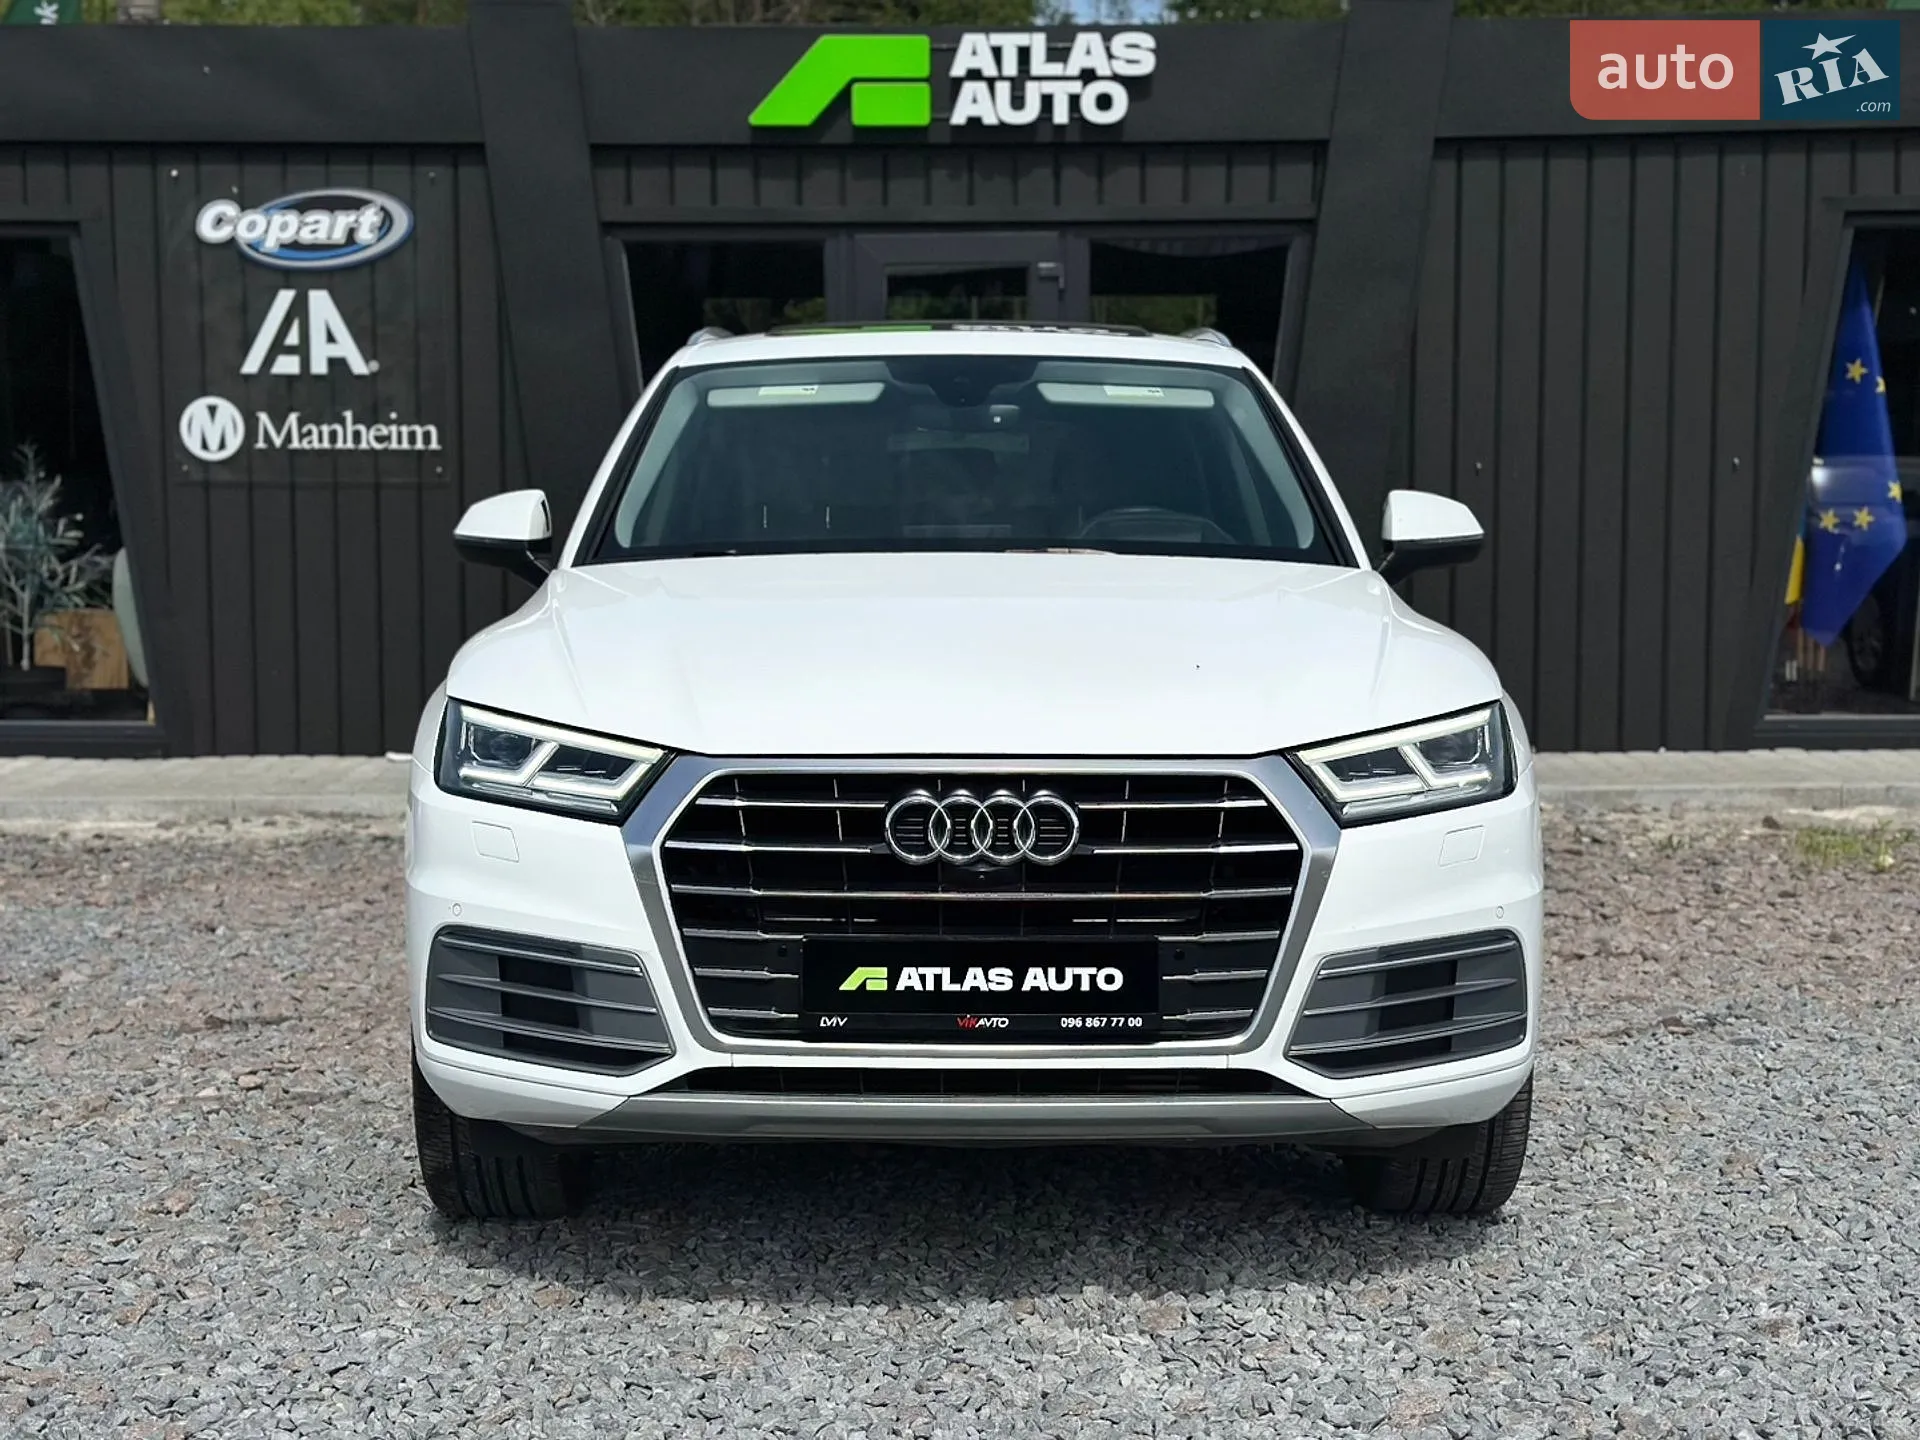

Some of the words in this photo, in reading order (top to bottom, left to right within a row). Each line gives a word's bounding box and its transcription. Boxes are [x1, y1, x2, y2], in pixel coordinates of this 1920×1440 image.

[949, 31, 1157, 77] ATLAS
[949, 79, 1129, 126] AUTO
[196, 199, 384, 252] Copart
[254, 410, 442, 451] Manheim
[895, 966, 1014, 992] ATLAS
[1021, 966, 1125, 992] AUTO
[1061, 1016, 1082, 1028] 096
[1085, 1016, 1107, 1028] 867
[1110, 1016, 1125, 1027] 77
[1127, 1016, 1143, 1027] 00
